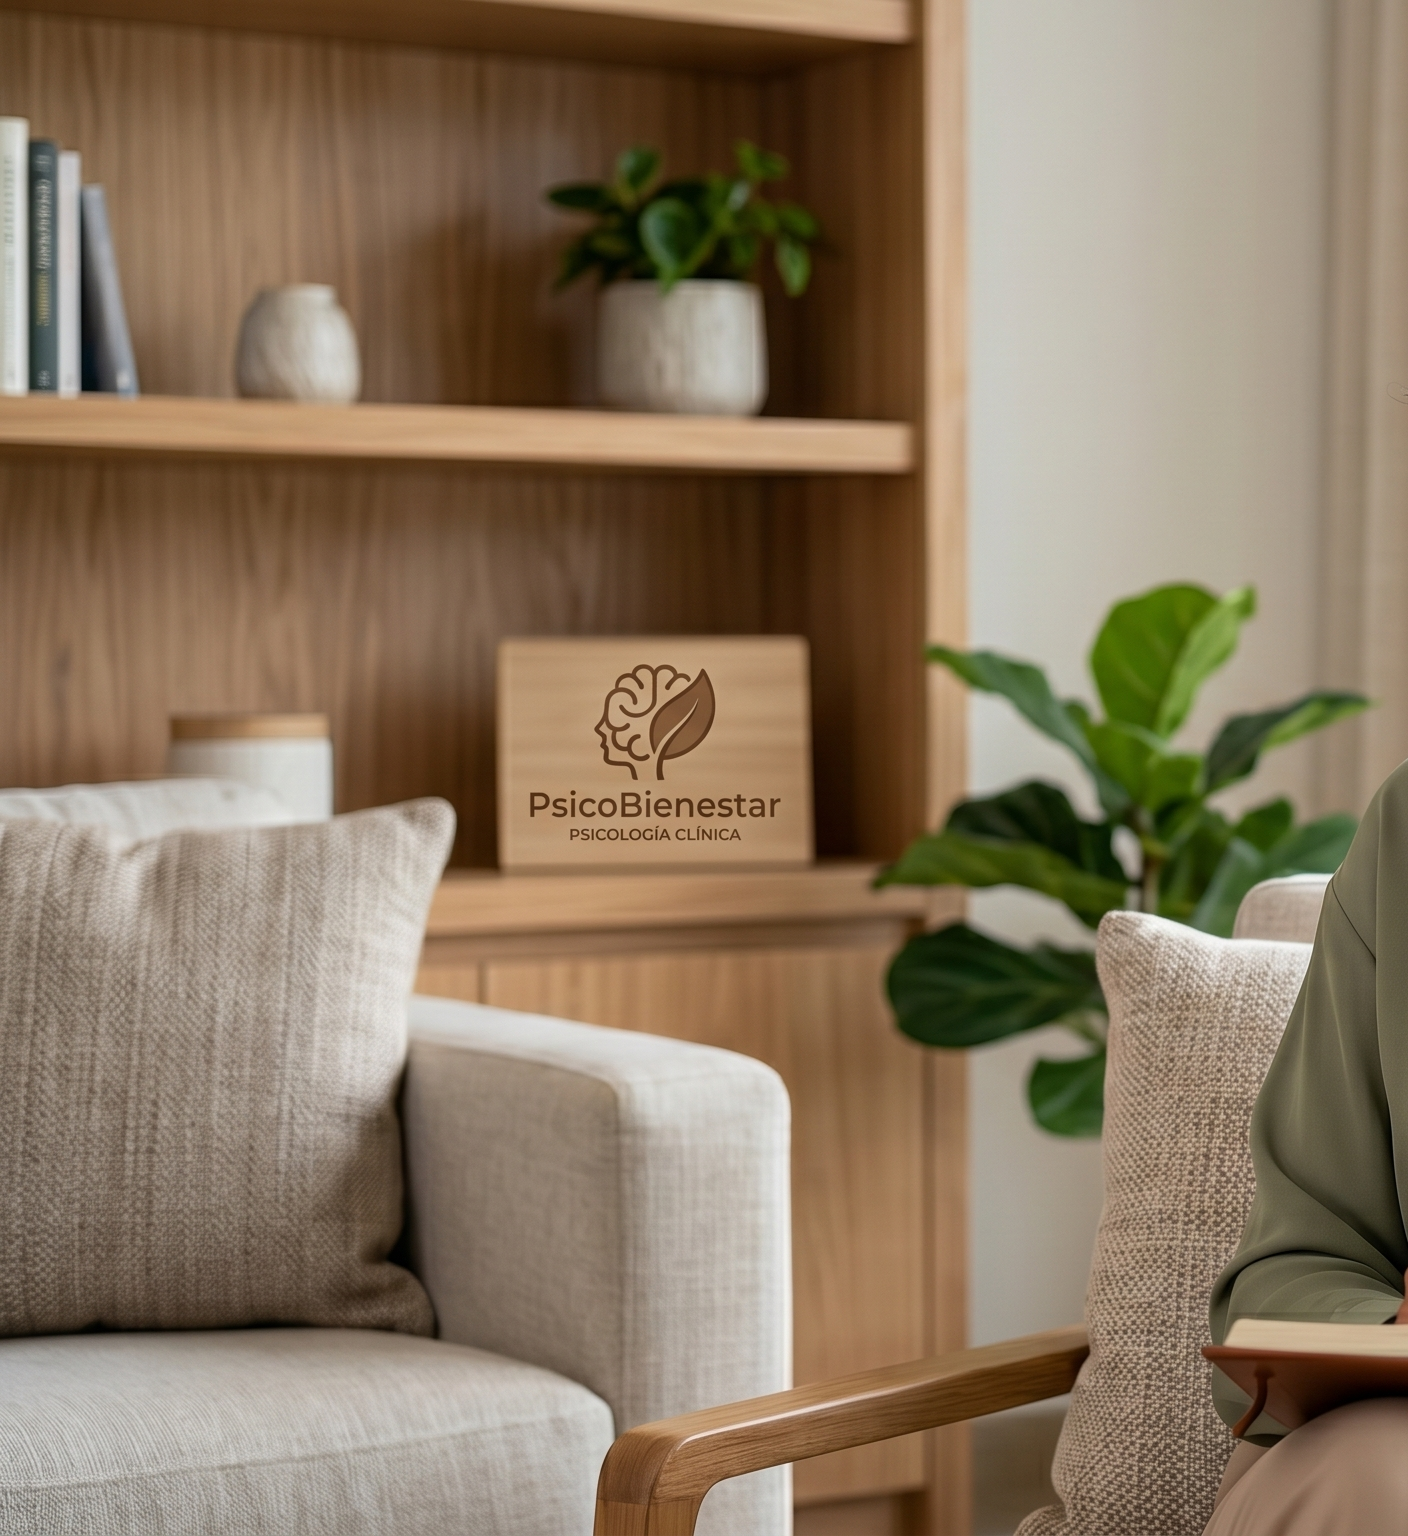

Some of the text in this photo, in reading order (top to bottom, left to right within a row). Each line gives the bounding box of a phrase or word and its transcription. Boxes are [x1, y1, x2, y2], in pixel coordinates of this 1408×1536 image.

[529, 790, 781, 818] PsicoBienestar
[569, 826, 742, 841] PSICOLOGÍA CLÍNICA
